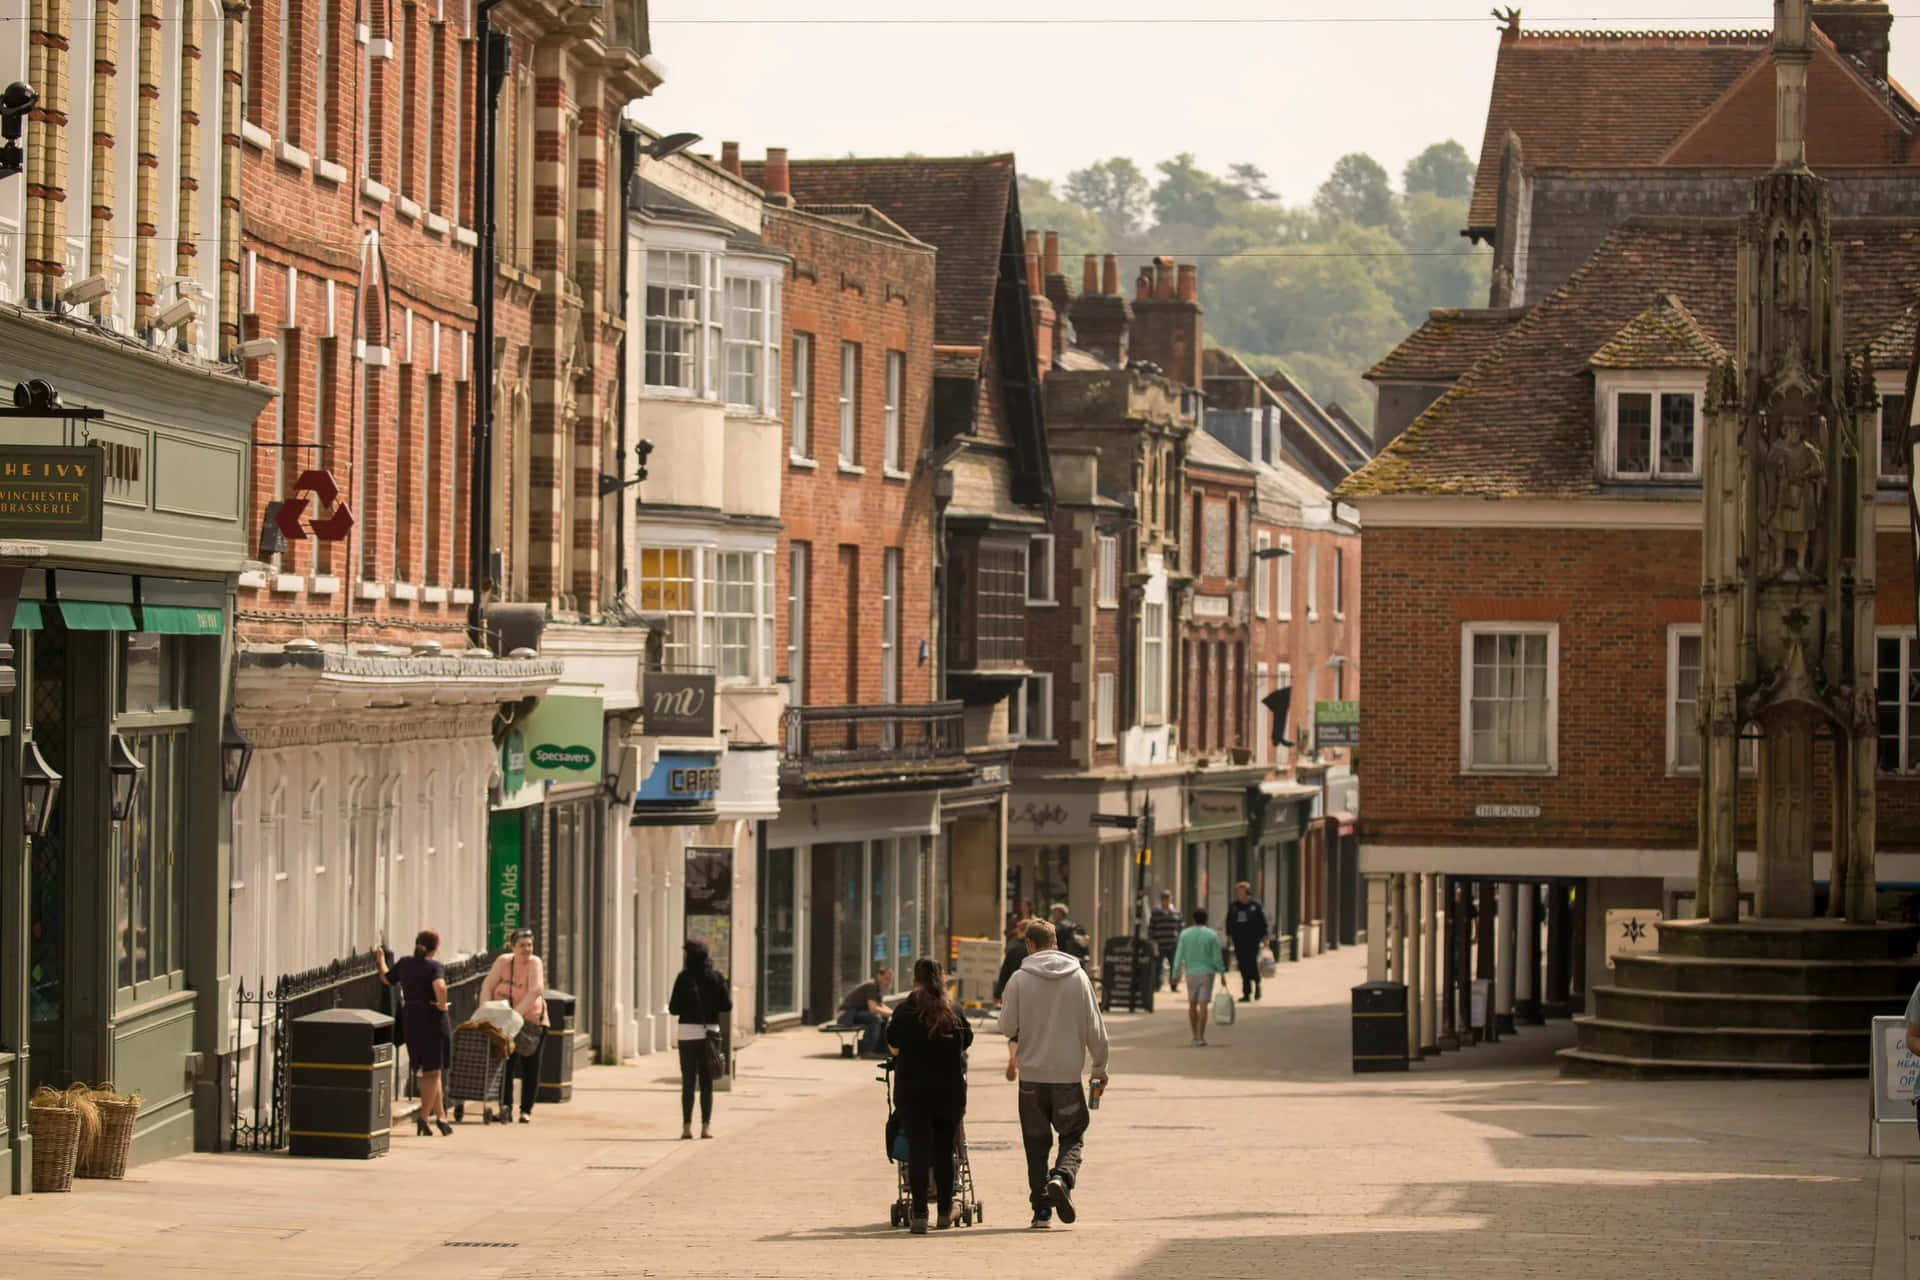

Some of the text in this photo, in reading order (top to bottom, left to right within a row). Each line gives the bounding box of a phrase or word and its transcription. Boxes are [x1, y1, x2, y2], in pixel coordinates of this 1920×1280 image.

[43, 463, 88, 477] IVY
[535, 750, 590, 763] Specsavers
[501, 863, 518, 898] Aids
